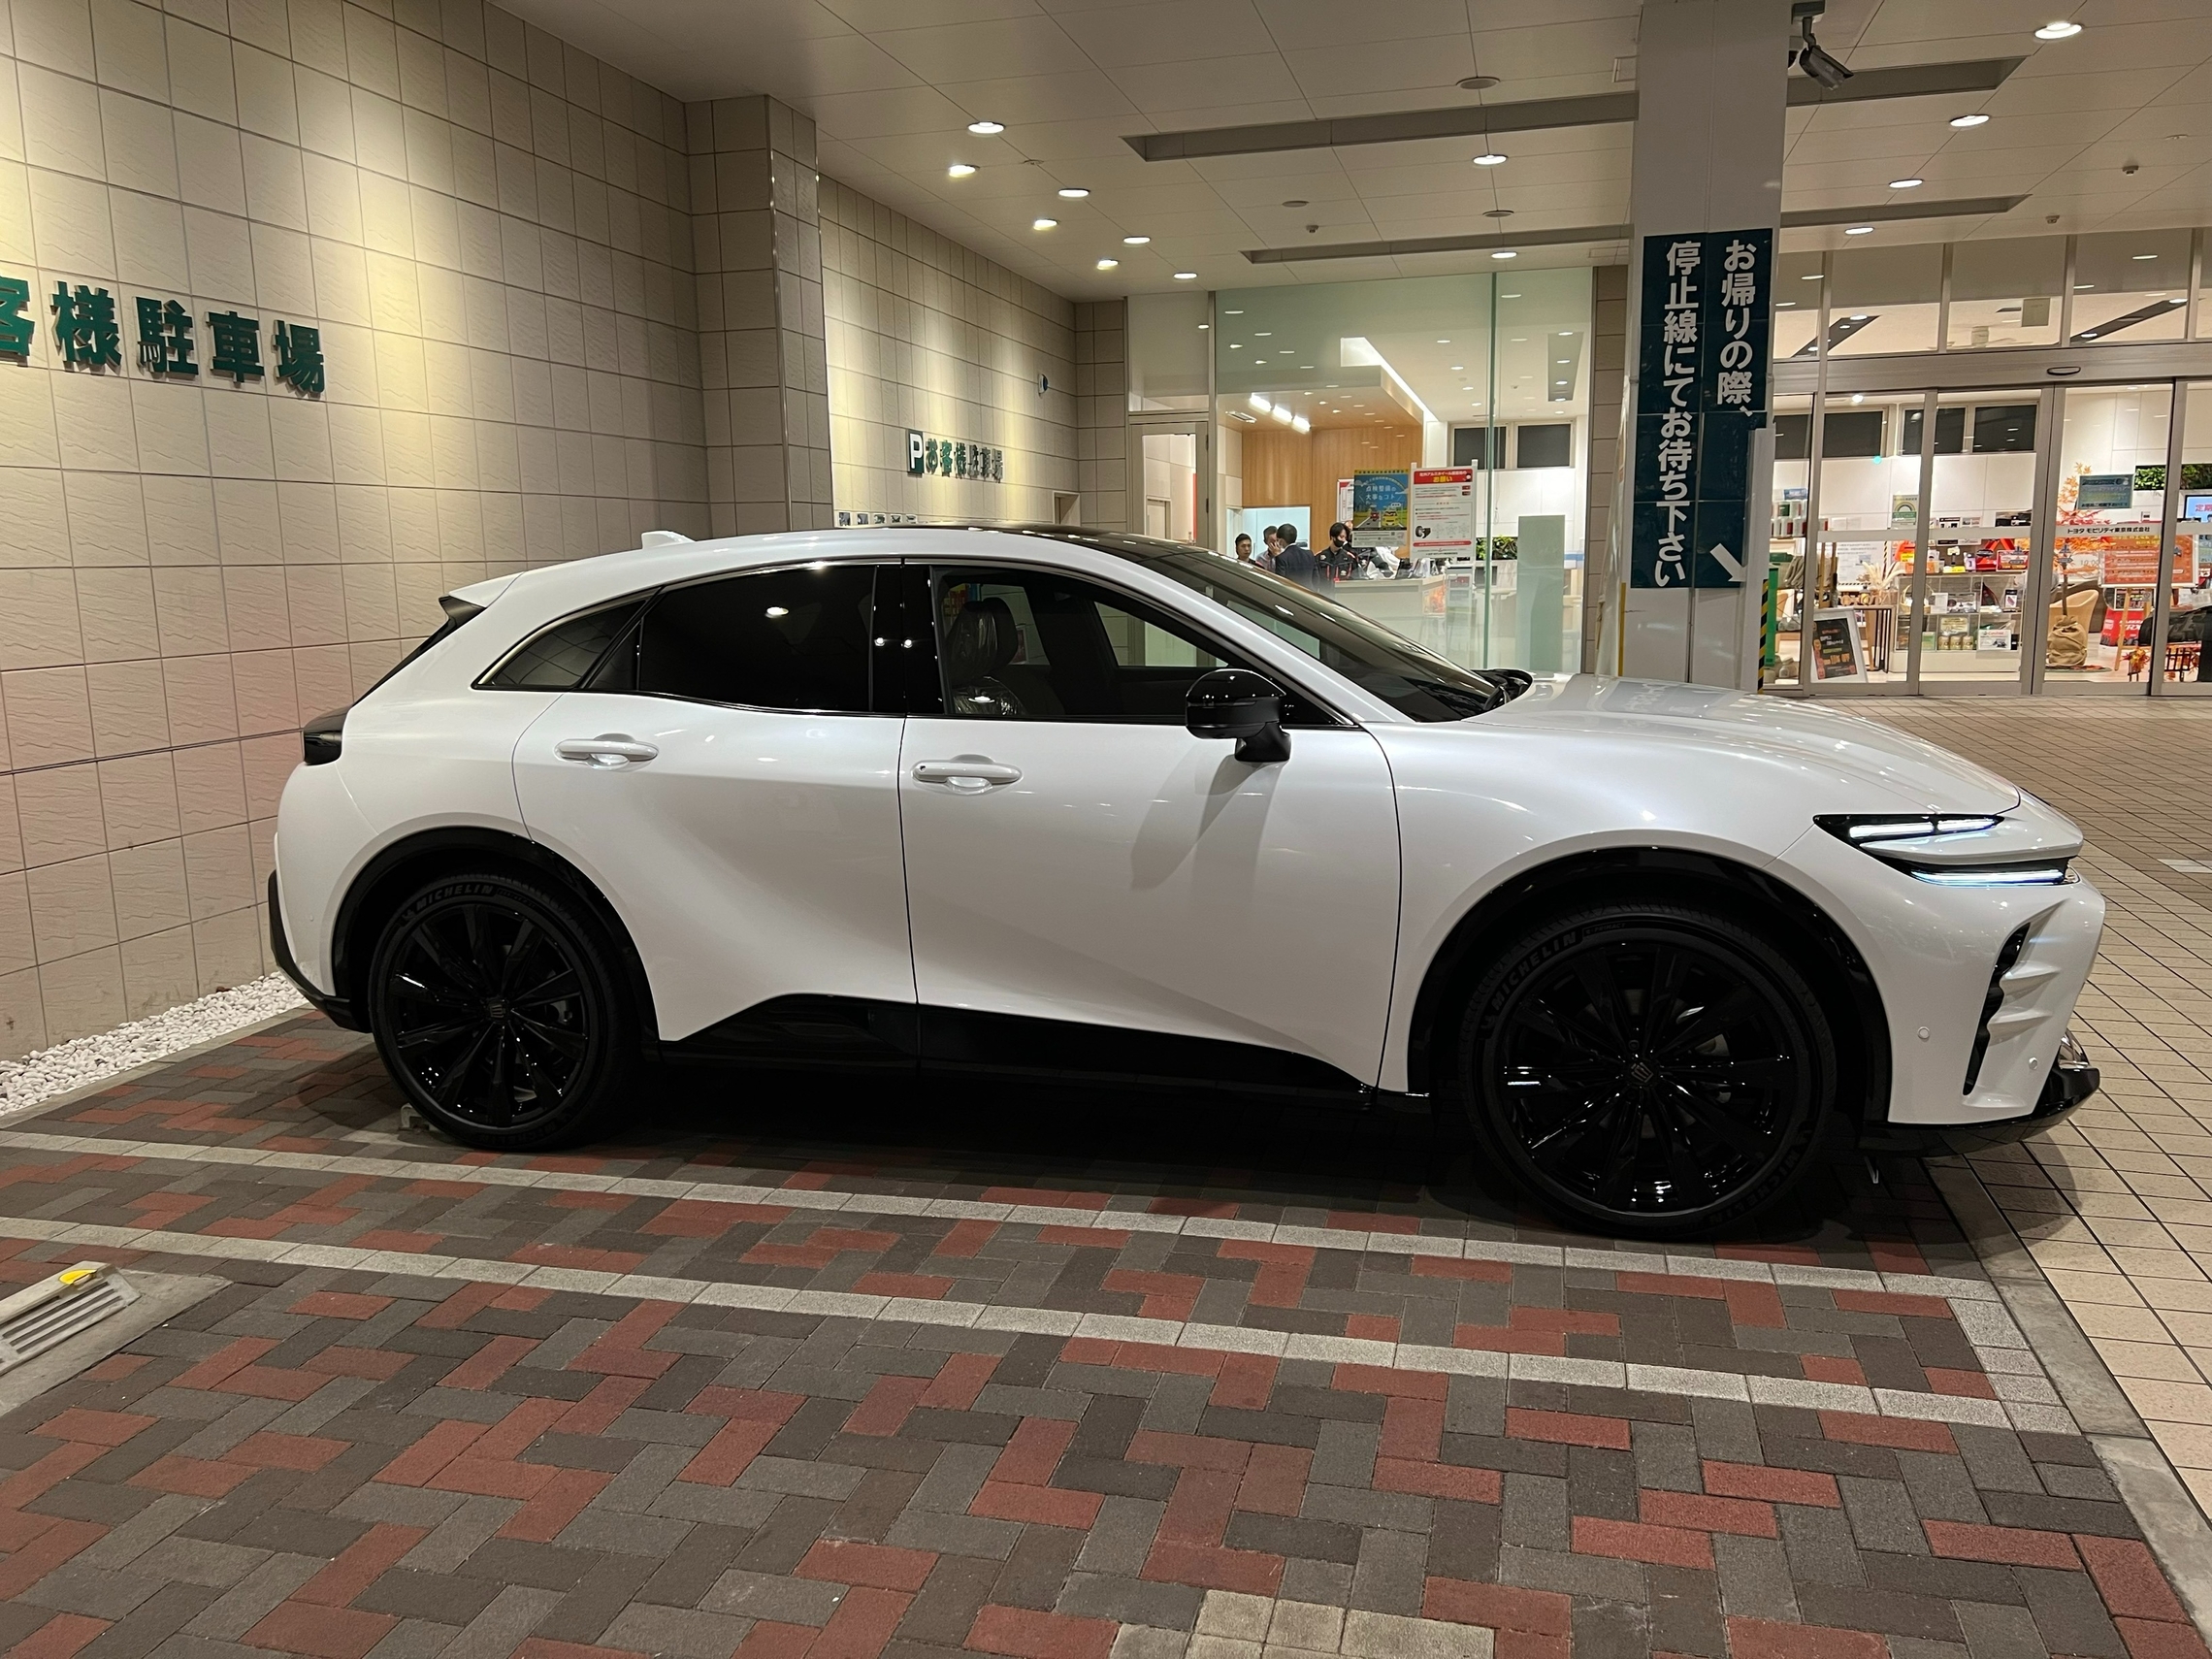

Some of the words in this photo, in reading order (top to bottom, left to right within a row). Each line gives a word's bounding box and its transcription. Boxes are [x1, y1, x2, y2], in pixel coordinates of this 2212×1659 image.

[1716, 239, 1757, 417] お帰りの際、
[1653, 241, 1702, 587] 停止線にてお待ち下さい
[415, 884, 494, 911] MICHELIN
[1491, 931, 1577, 1011] MICHELIN
